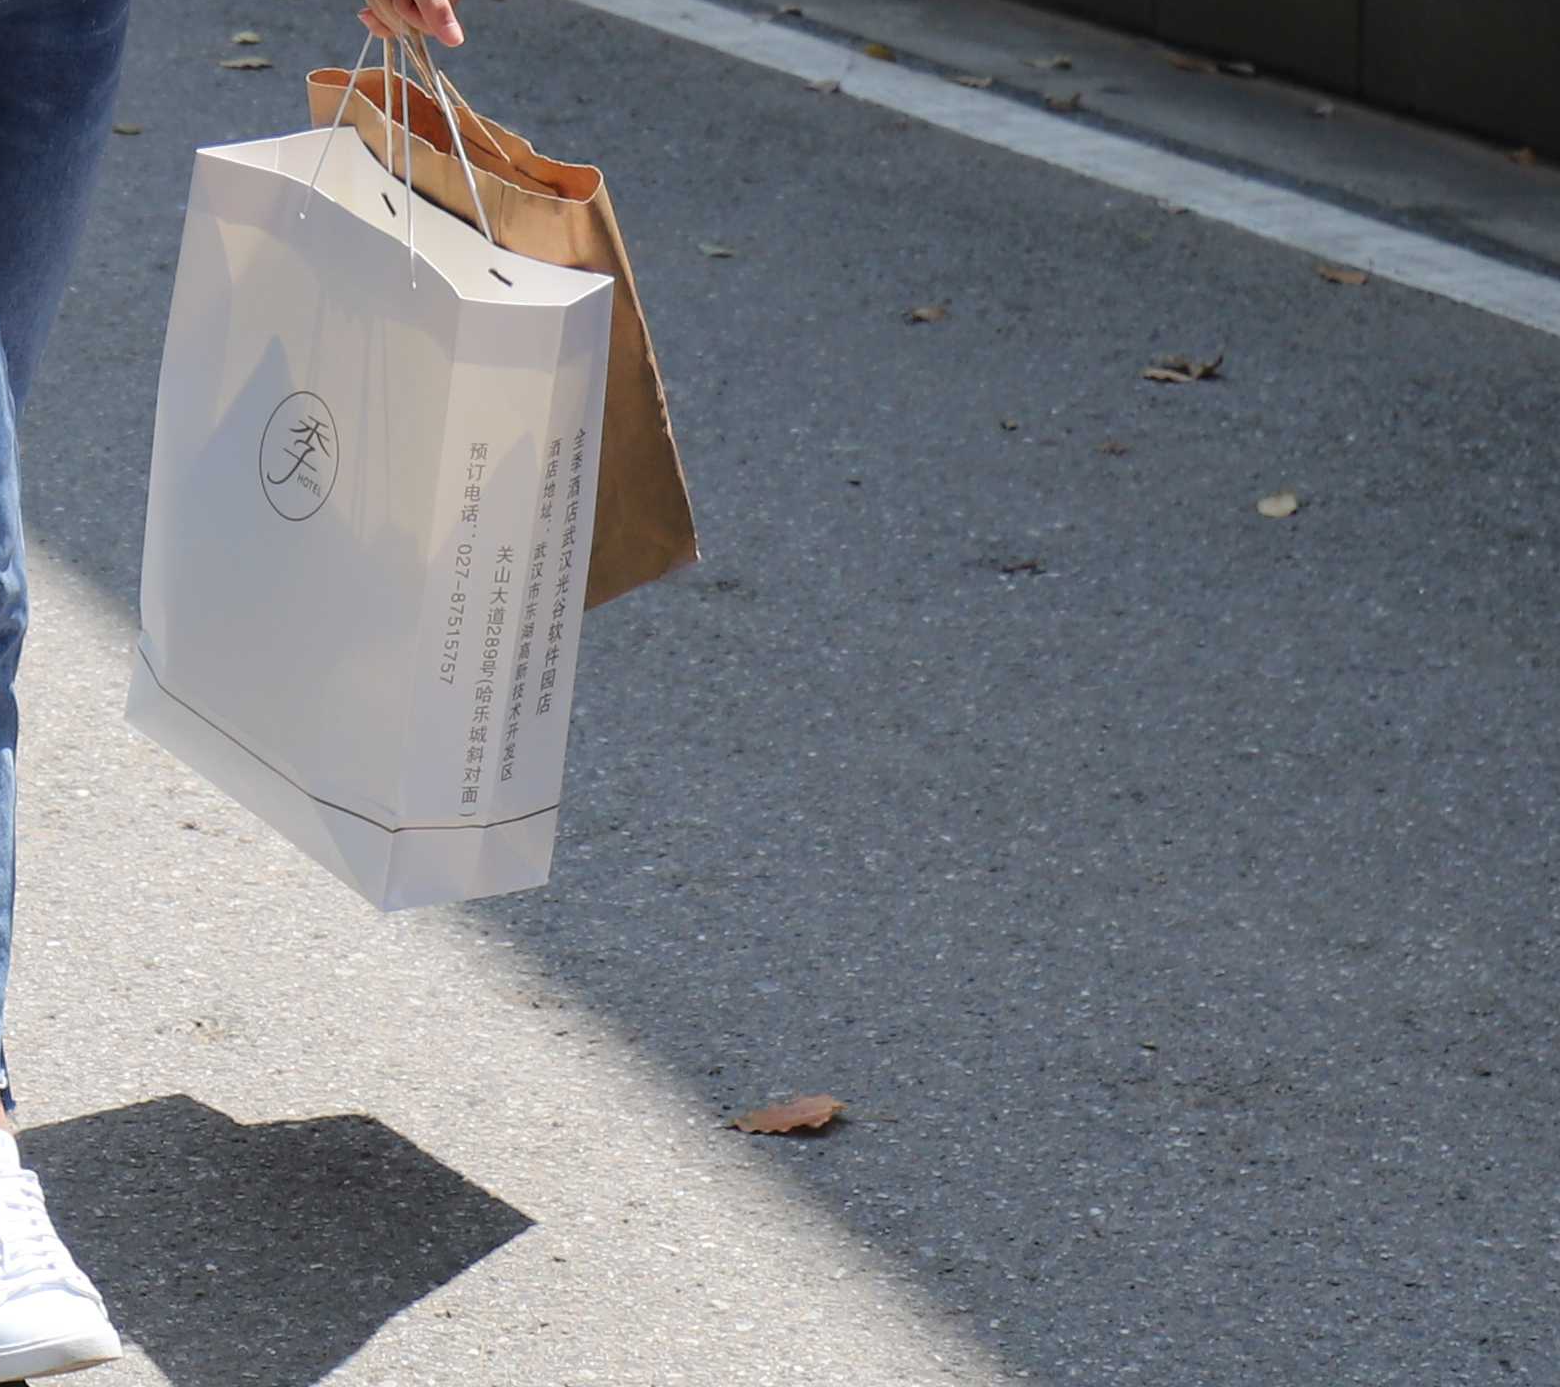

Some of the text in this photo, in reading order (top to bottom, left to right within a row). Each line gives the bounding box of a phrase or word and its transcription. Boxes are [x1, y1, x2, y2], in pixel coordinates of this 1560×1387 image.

[266, 415, 331, 484] 季
[296, 473, 321, 498] HOTEL
[535, 428, 586, 716] 全季酒店武汉光谷软件园店
